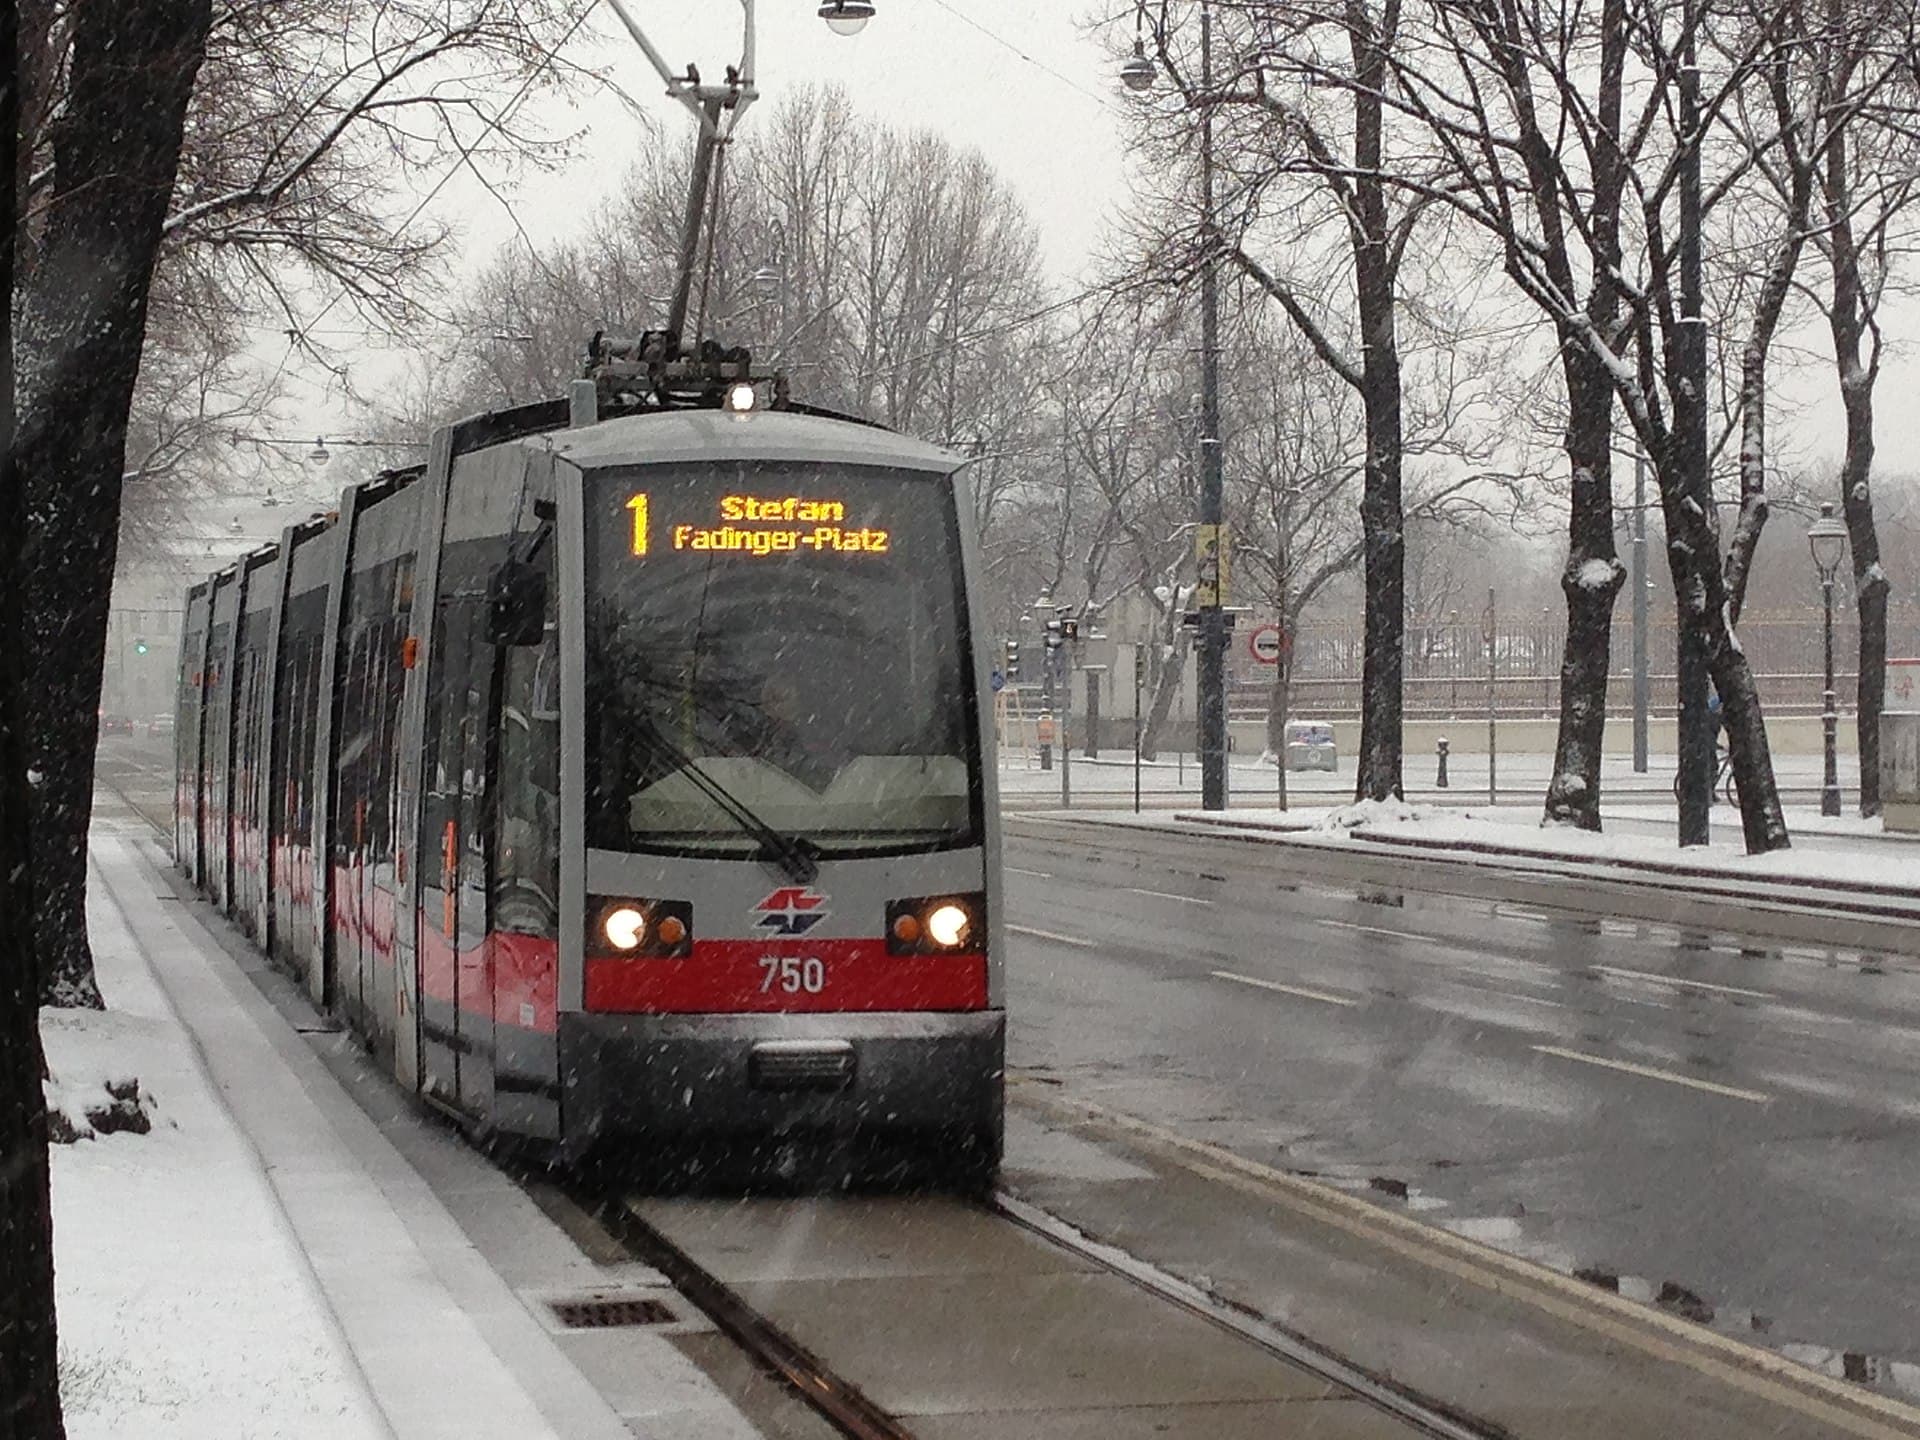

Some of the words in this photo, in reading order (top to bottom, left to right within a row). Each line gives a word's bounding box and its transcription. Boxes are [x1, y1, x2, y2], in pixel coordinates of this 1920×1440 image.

[626, 493, 648, 556] 1
[720, 496, 845, 521] Stefan
[675, 526, 888, 555] Fadinger-Platz
[758, 957, 825, 993] 750
